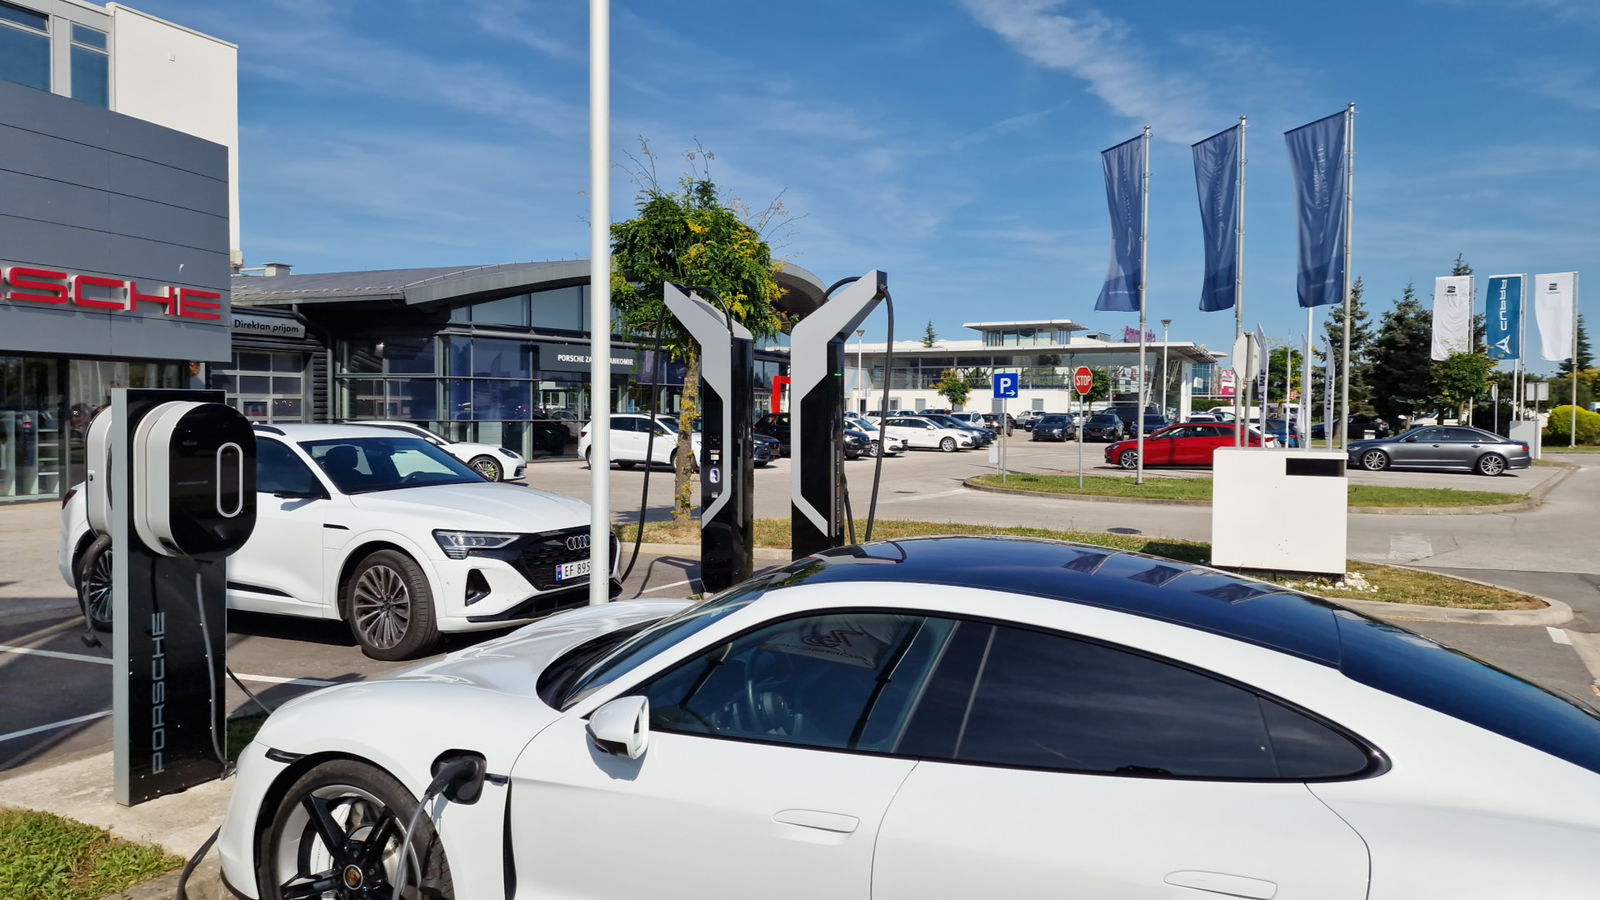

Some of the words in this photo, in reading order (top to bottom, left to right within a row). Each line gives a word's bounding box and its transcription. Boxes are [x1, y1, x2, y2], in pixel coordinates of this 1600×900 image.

[0, 266, 223, 320] SCHE
[234, 319, 271, 331] Direktan
[557, 354, 585, 363] PORSCHE
[609, 357, 634, 366] ANKOMIR
[1000, 378, 1012, 394] P
[1076, 375, 1091, 386] STOP
[577, 562, 591, 574] 895
[152, 611, 165, 775] PORSCHE
